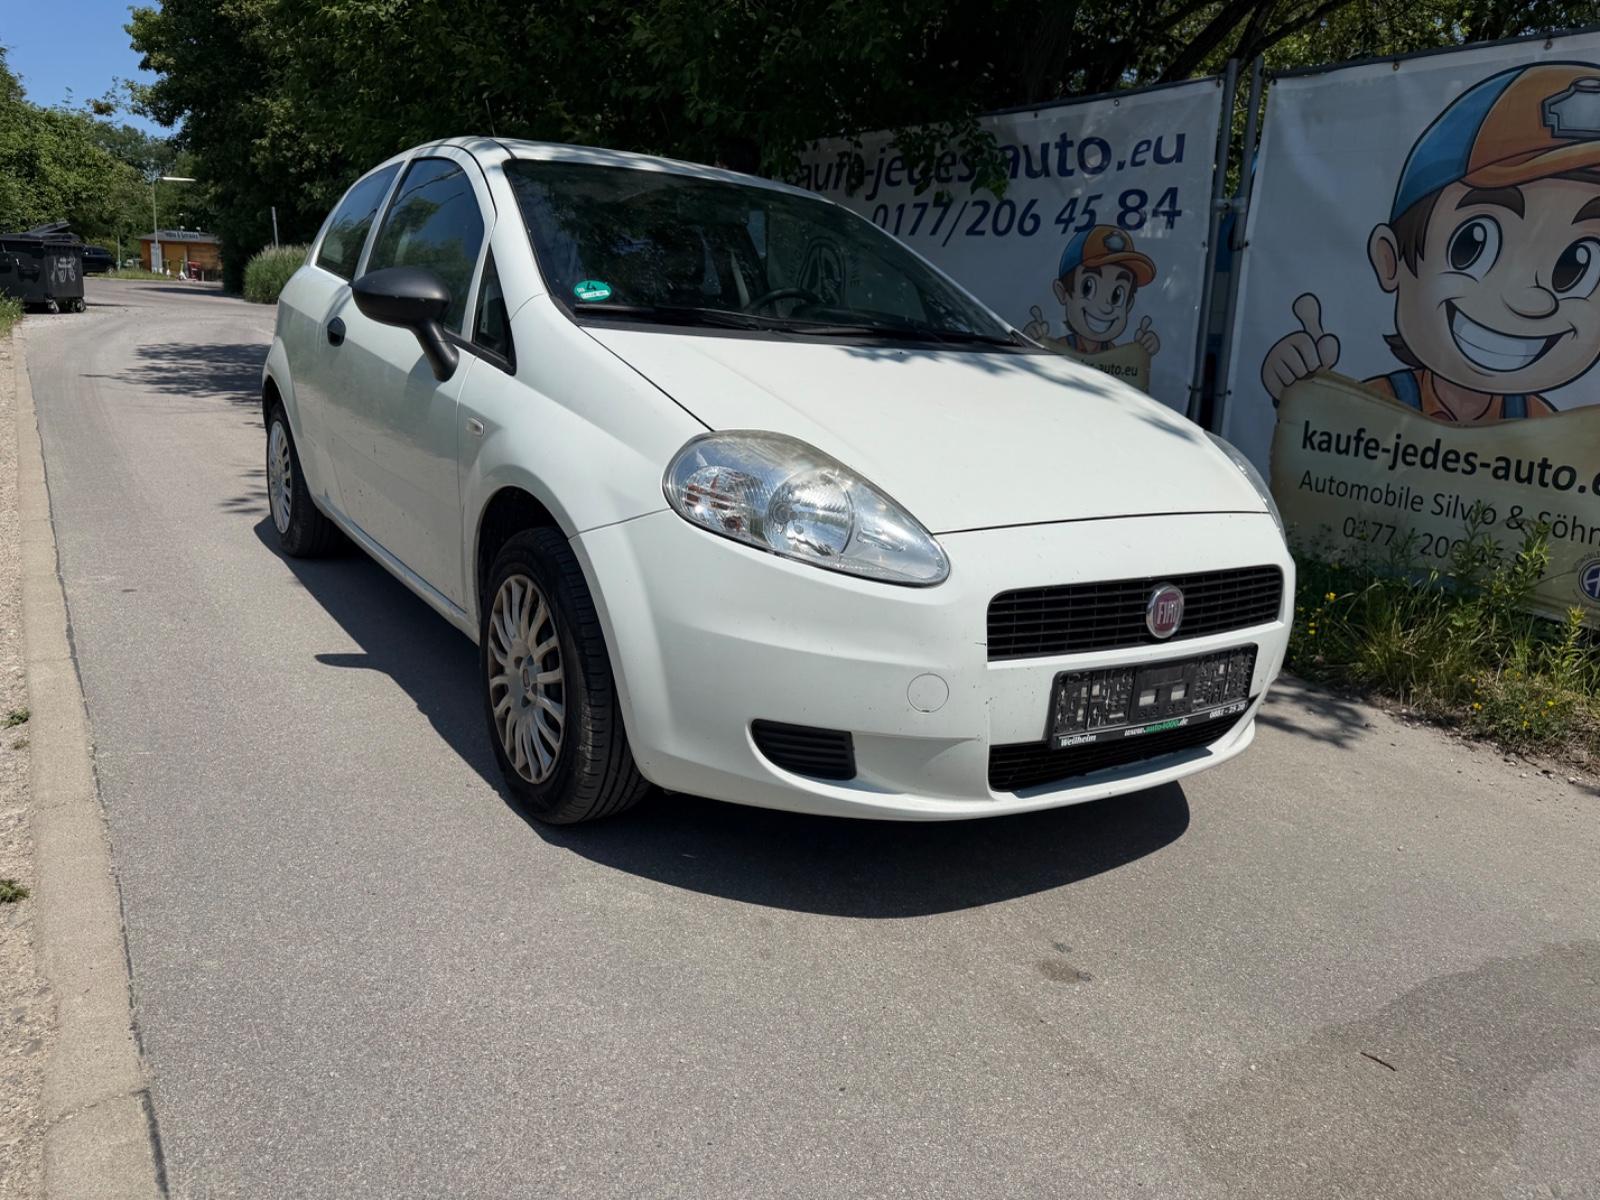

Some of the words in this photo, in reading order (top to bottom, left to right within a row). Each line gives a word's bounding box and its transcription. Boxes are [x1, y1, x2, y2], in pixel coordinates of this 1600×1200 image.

[1055, 195, 1097, 234] 45
[1117, 186, 1182, 231] 84
[1299, 469, 1424, 512] Automobile
[1431, 492, 1497, 526] Silvo
[1505, 504, 1526, 531] &
[1156, 599, 1181, 625] FIAT
